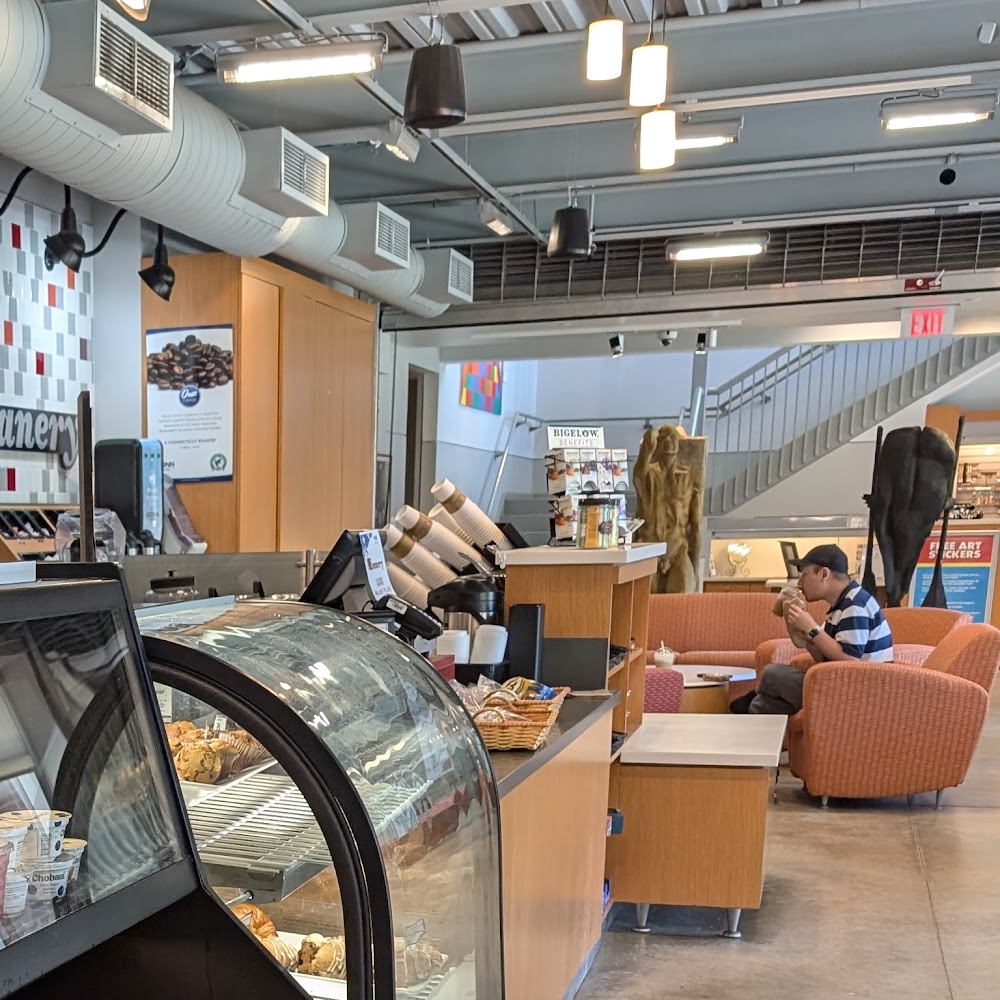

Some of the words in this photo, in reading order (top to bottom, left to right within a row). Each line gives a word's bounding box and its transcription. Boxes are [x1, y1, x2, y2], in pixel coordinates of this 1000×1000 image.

[910, 308, 945, 336] EXIT
[958, 541, 982, 551] ART
[928, 550, 981, 560] SICKERS
[31, 872, 66, 883] Chobani
